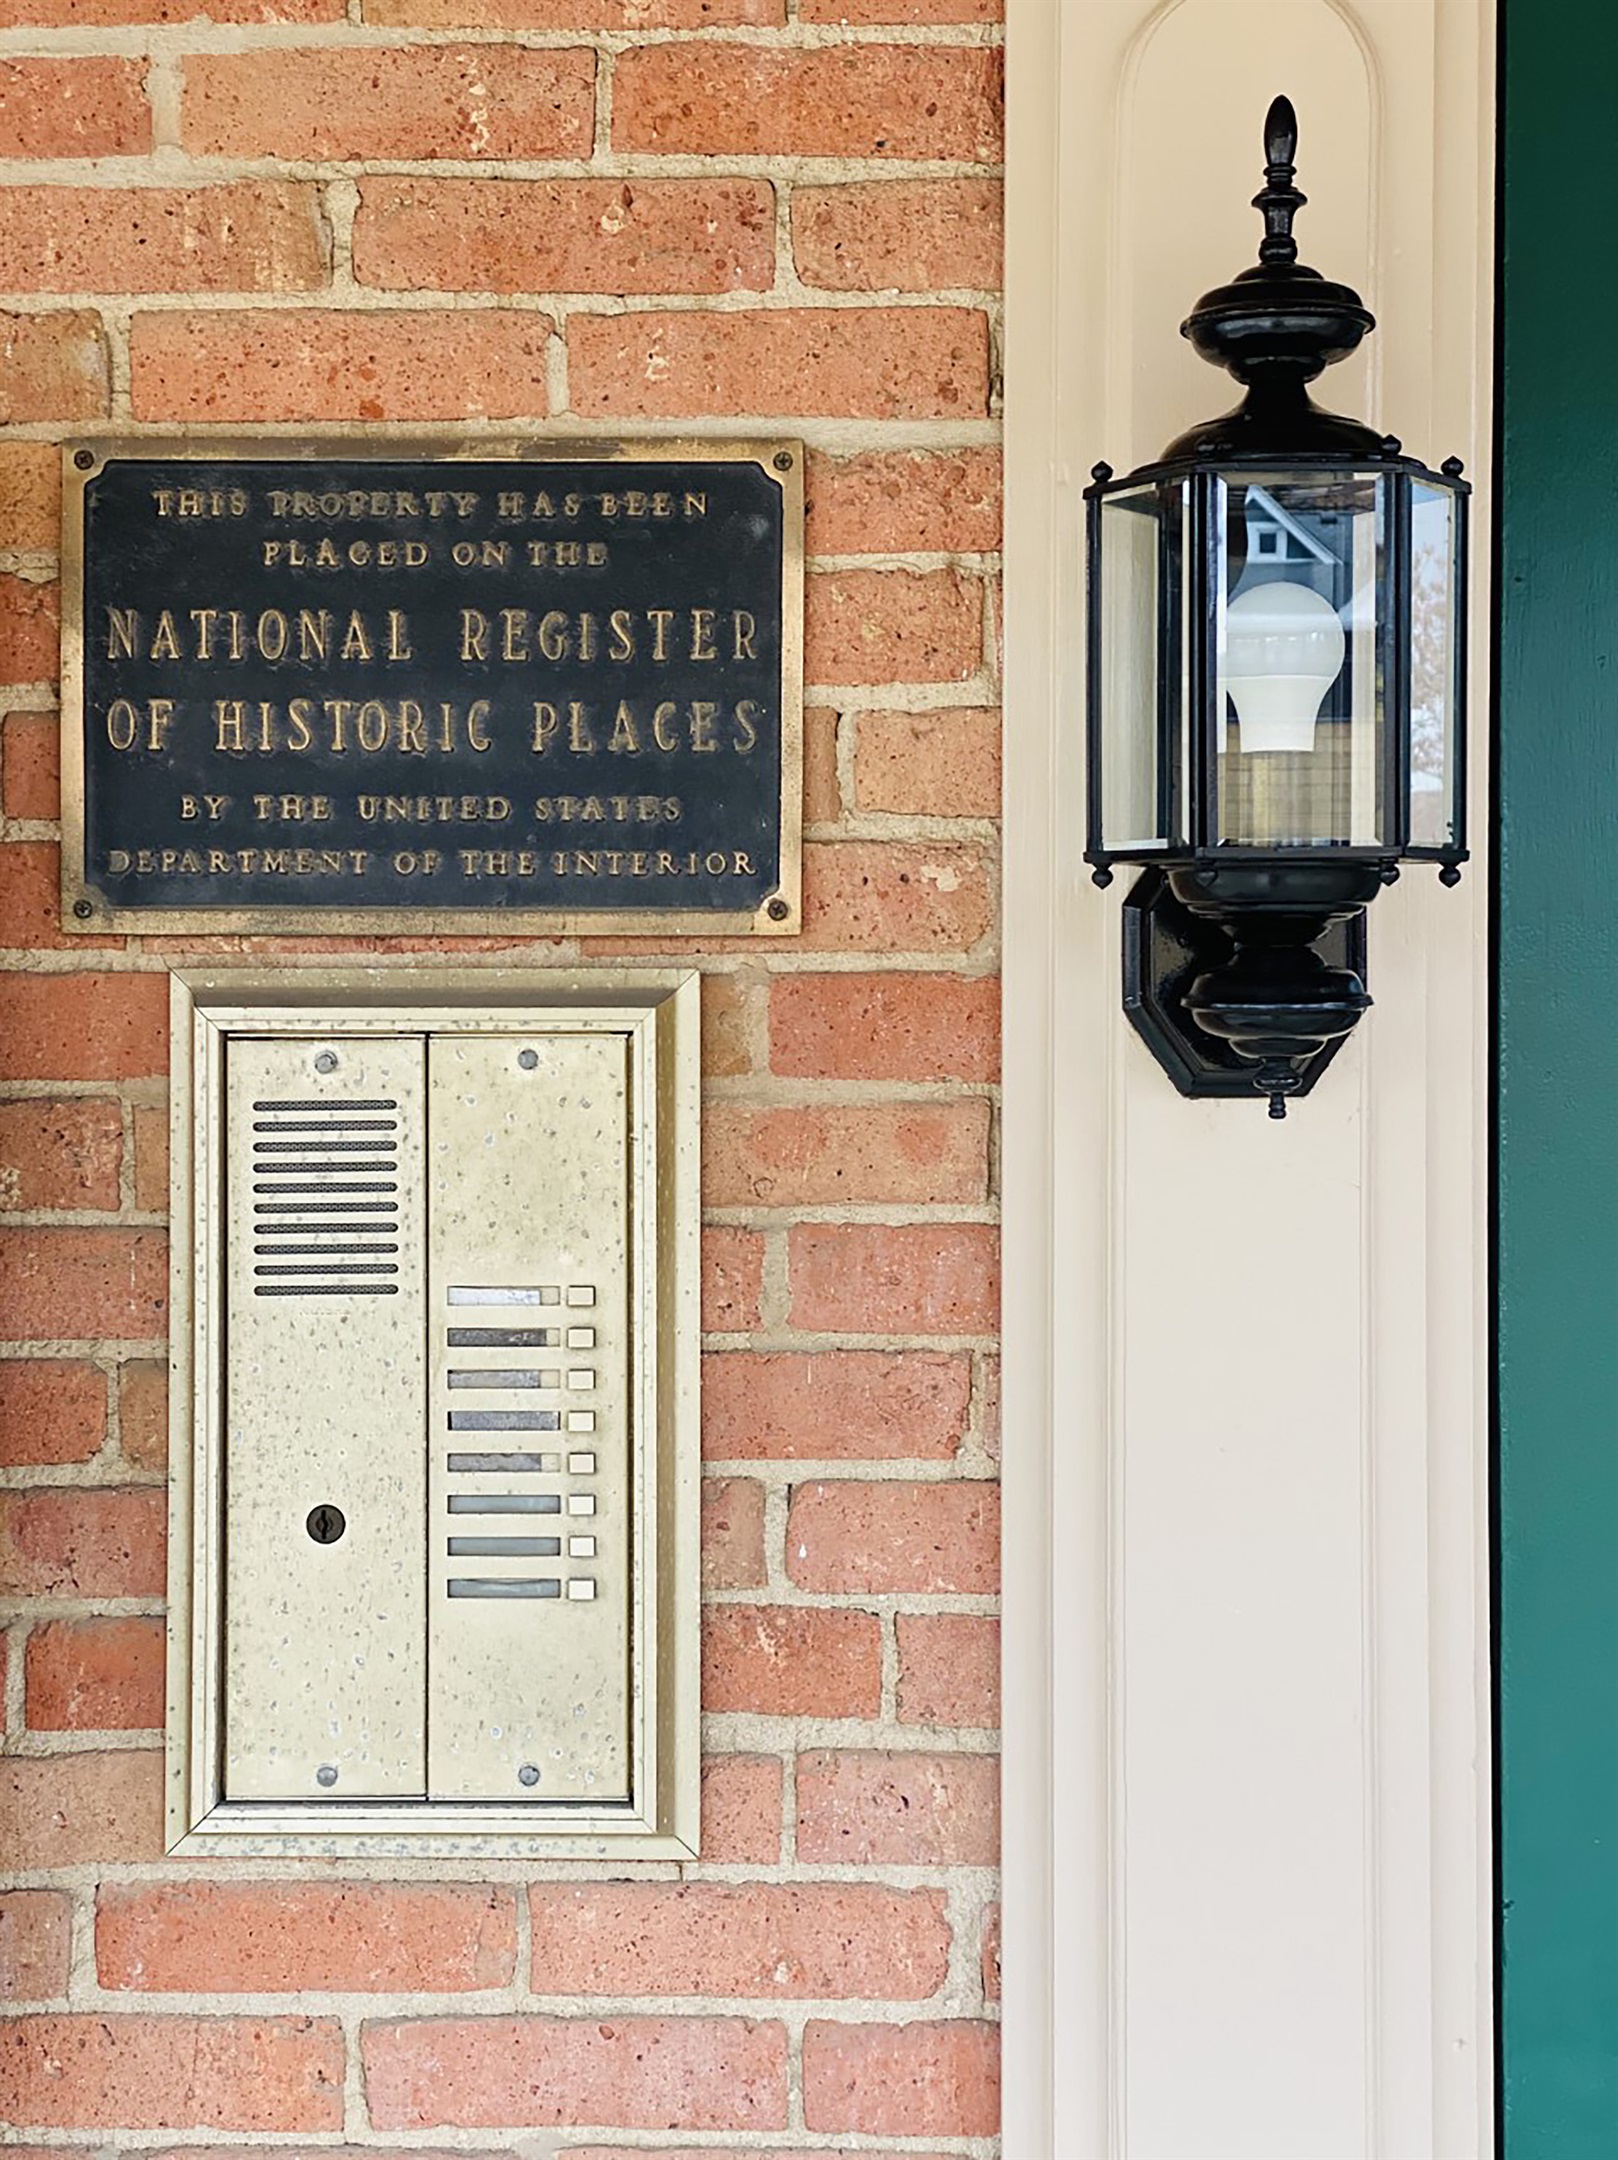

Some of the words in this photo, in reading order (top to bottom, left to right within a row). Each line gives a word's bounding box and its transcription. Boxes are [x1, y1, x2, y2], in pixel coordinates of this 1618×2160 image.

[152, 489, 248, 516] THIS
[271, 490, 479, 518] PROPERTY
[499, 490, 582, 517] HAS
[602, 491, 709, 518] BEEN
[263, 540, 429, 567] PLACED
[452, 541, 507, 567] ON
[528, 541, 608, 567] THE
[106, 609, 412, 661] NATIONAL
[460, 609, 759, 662] REGISTER
[106, 699, 175, 751] OF
[214, 698, 492, 753] HISTORIC
[531, 698, 759, 752] PLACES
[180, 795, 226, 820] BY
[254, 795, 330, 820] THE
[358, 795, 510, 821] UNITED
[536, 795, 682, 820] STATES
[107, 850, 367, 876] DEPARTMENT
[396, 849, 444, 876] OF
[460, 850, 535, 876] THE
[555, 850, 758, 876] INTERIOR
